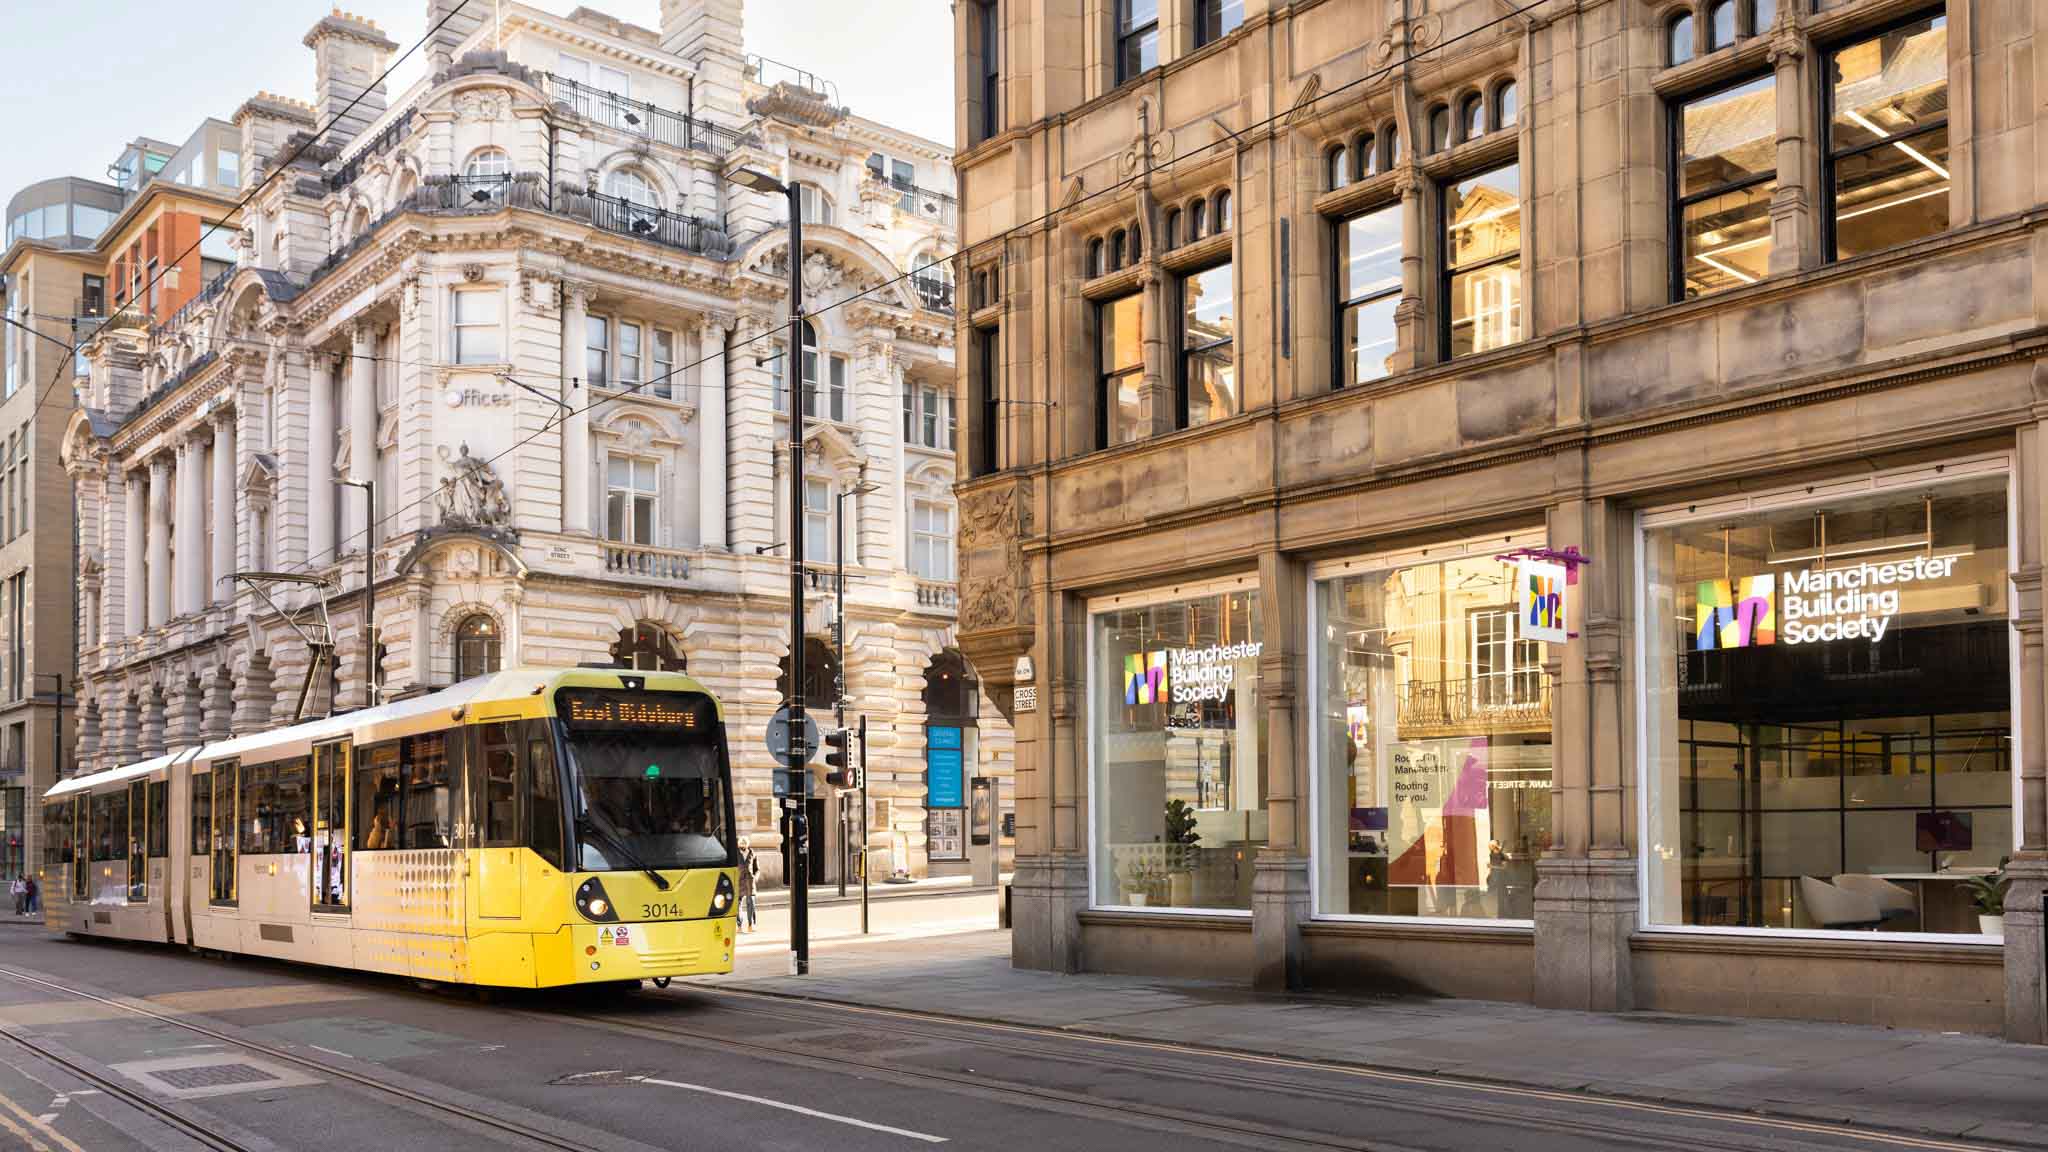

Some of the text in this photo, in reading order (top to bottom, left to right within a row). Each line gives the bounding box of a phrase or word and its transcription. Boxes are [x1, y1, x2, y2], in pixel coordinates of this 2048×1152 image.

[1783, 555, 1957, 594] Manchester
[1784, 589, 1899, 620] Building
[1784, 616, 1889, 645] Society
[1172, 640, 1263, 664] Manchester
[1172, 664, 1233, 684] Building
[1015, 689, 1037, 699] CROSS
[1173, 682, 1228, 702] Society
[571, 701, 613, 720] East
[1015, 699, 1035, 709] STREET
[1395, 781, 1429, 791] Rooting
